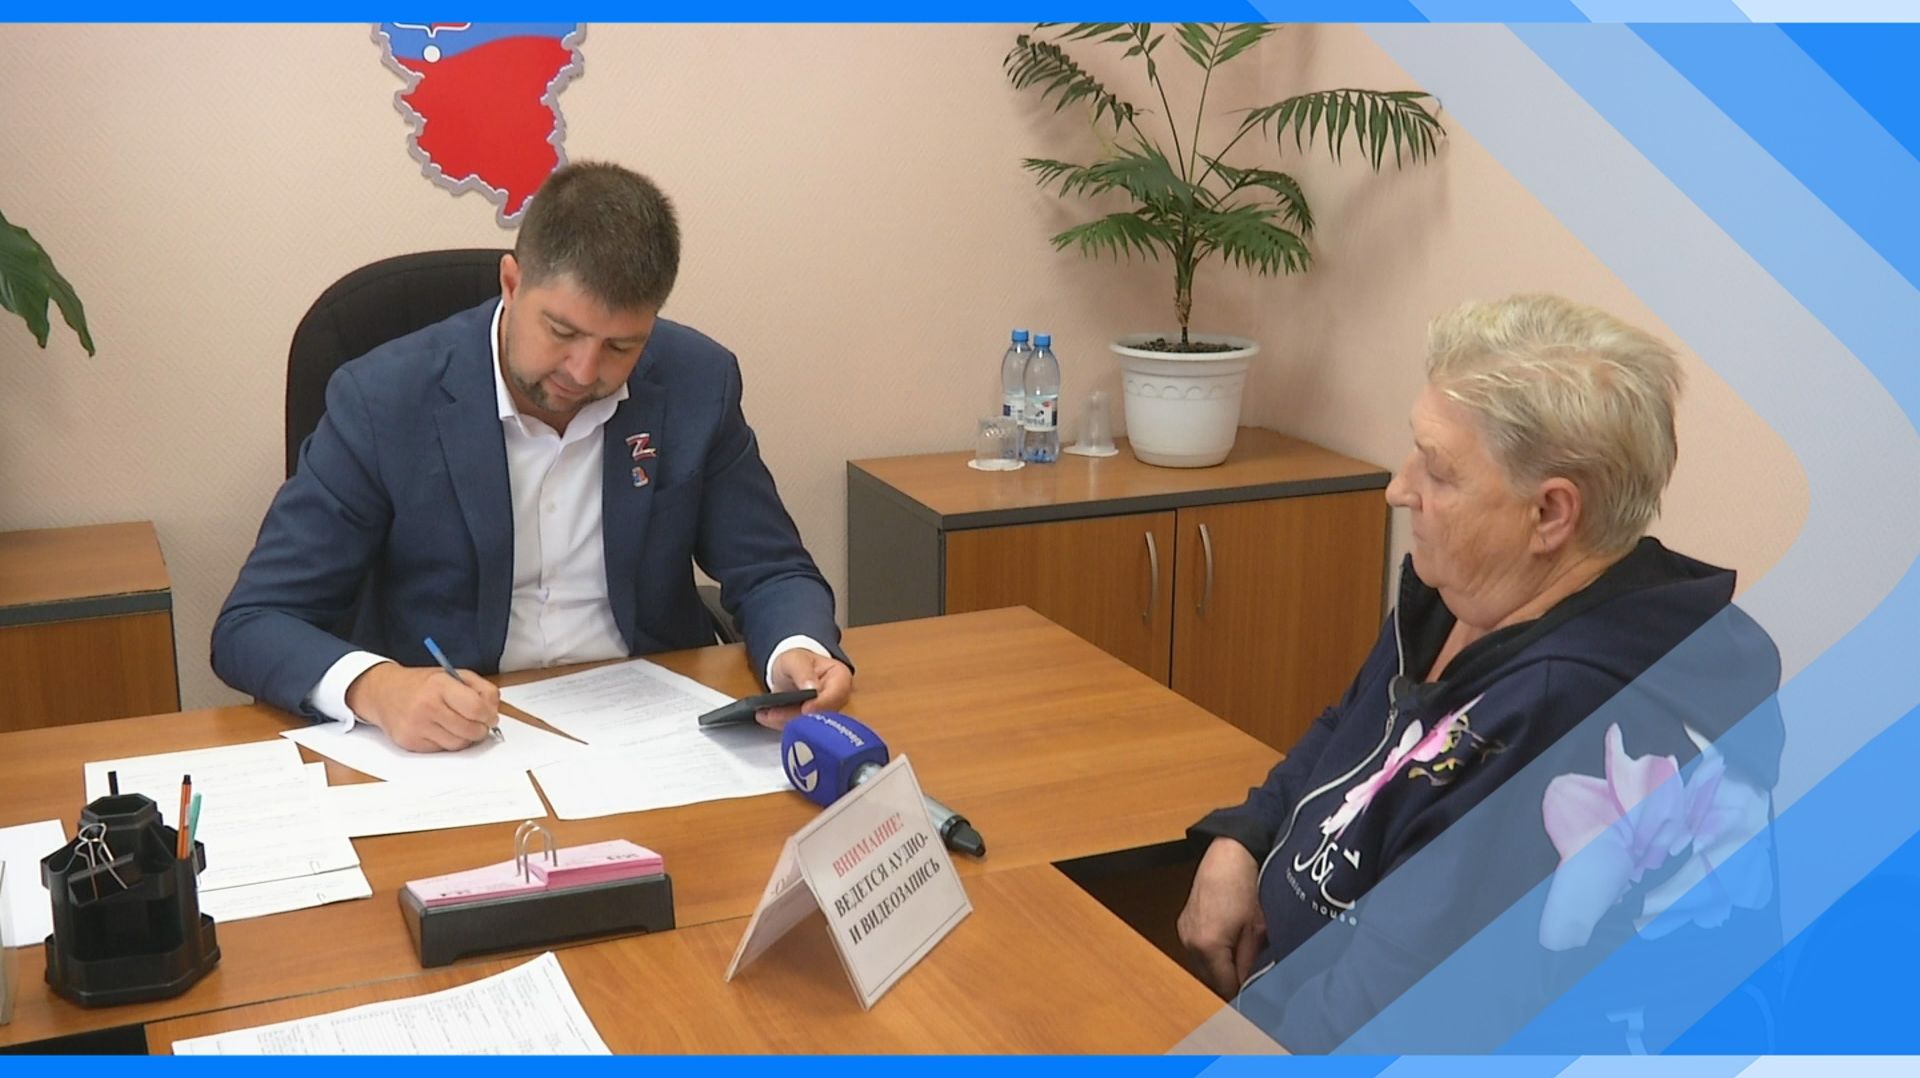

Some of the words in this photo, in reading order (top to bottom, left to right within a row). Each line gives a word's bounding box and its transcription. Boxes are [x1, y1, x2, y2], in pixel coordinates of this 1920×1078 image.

[832, 812, 904, 878] ВНИМАНИЕ!
[834, 861, 889, 918] ВЕДЕТСЯ
[888, 832, 928, 873] АУДИО-
[849, 924, 863, 945] И
[860, 857, 941, 935] ВИДЕОЗАПИСЬ
